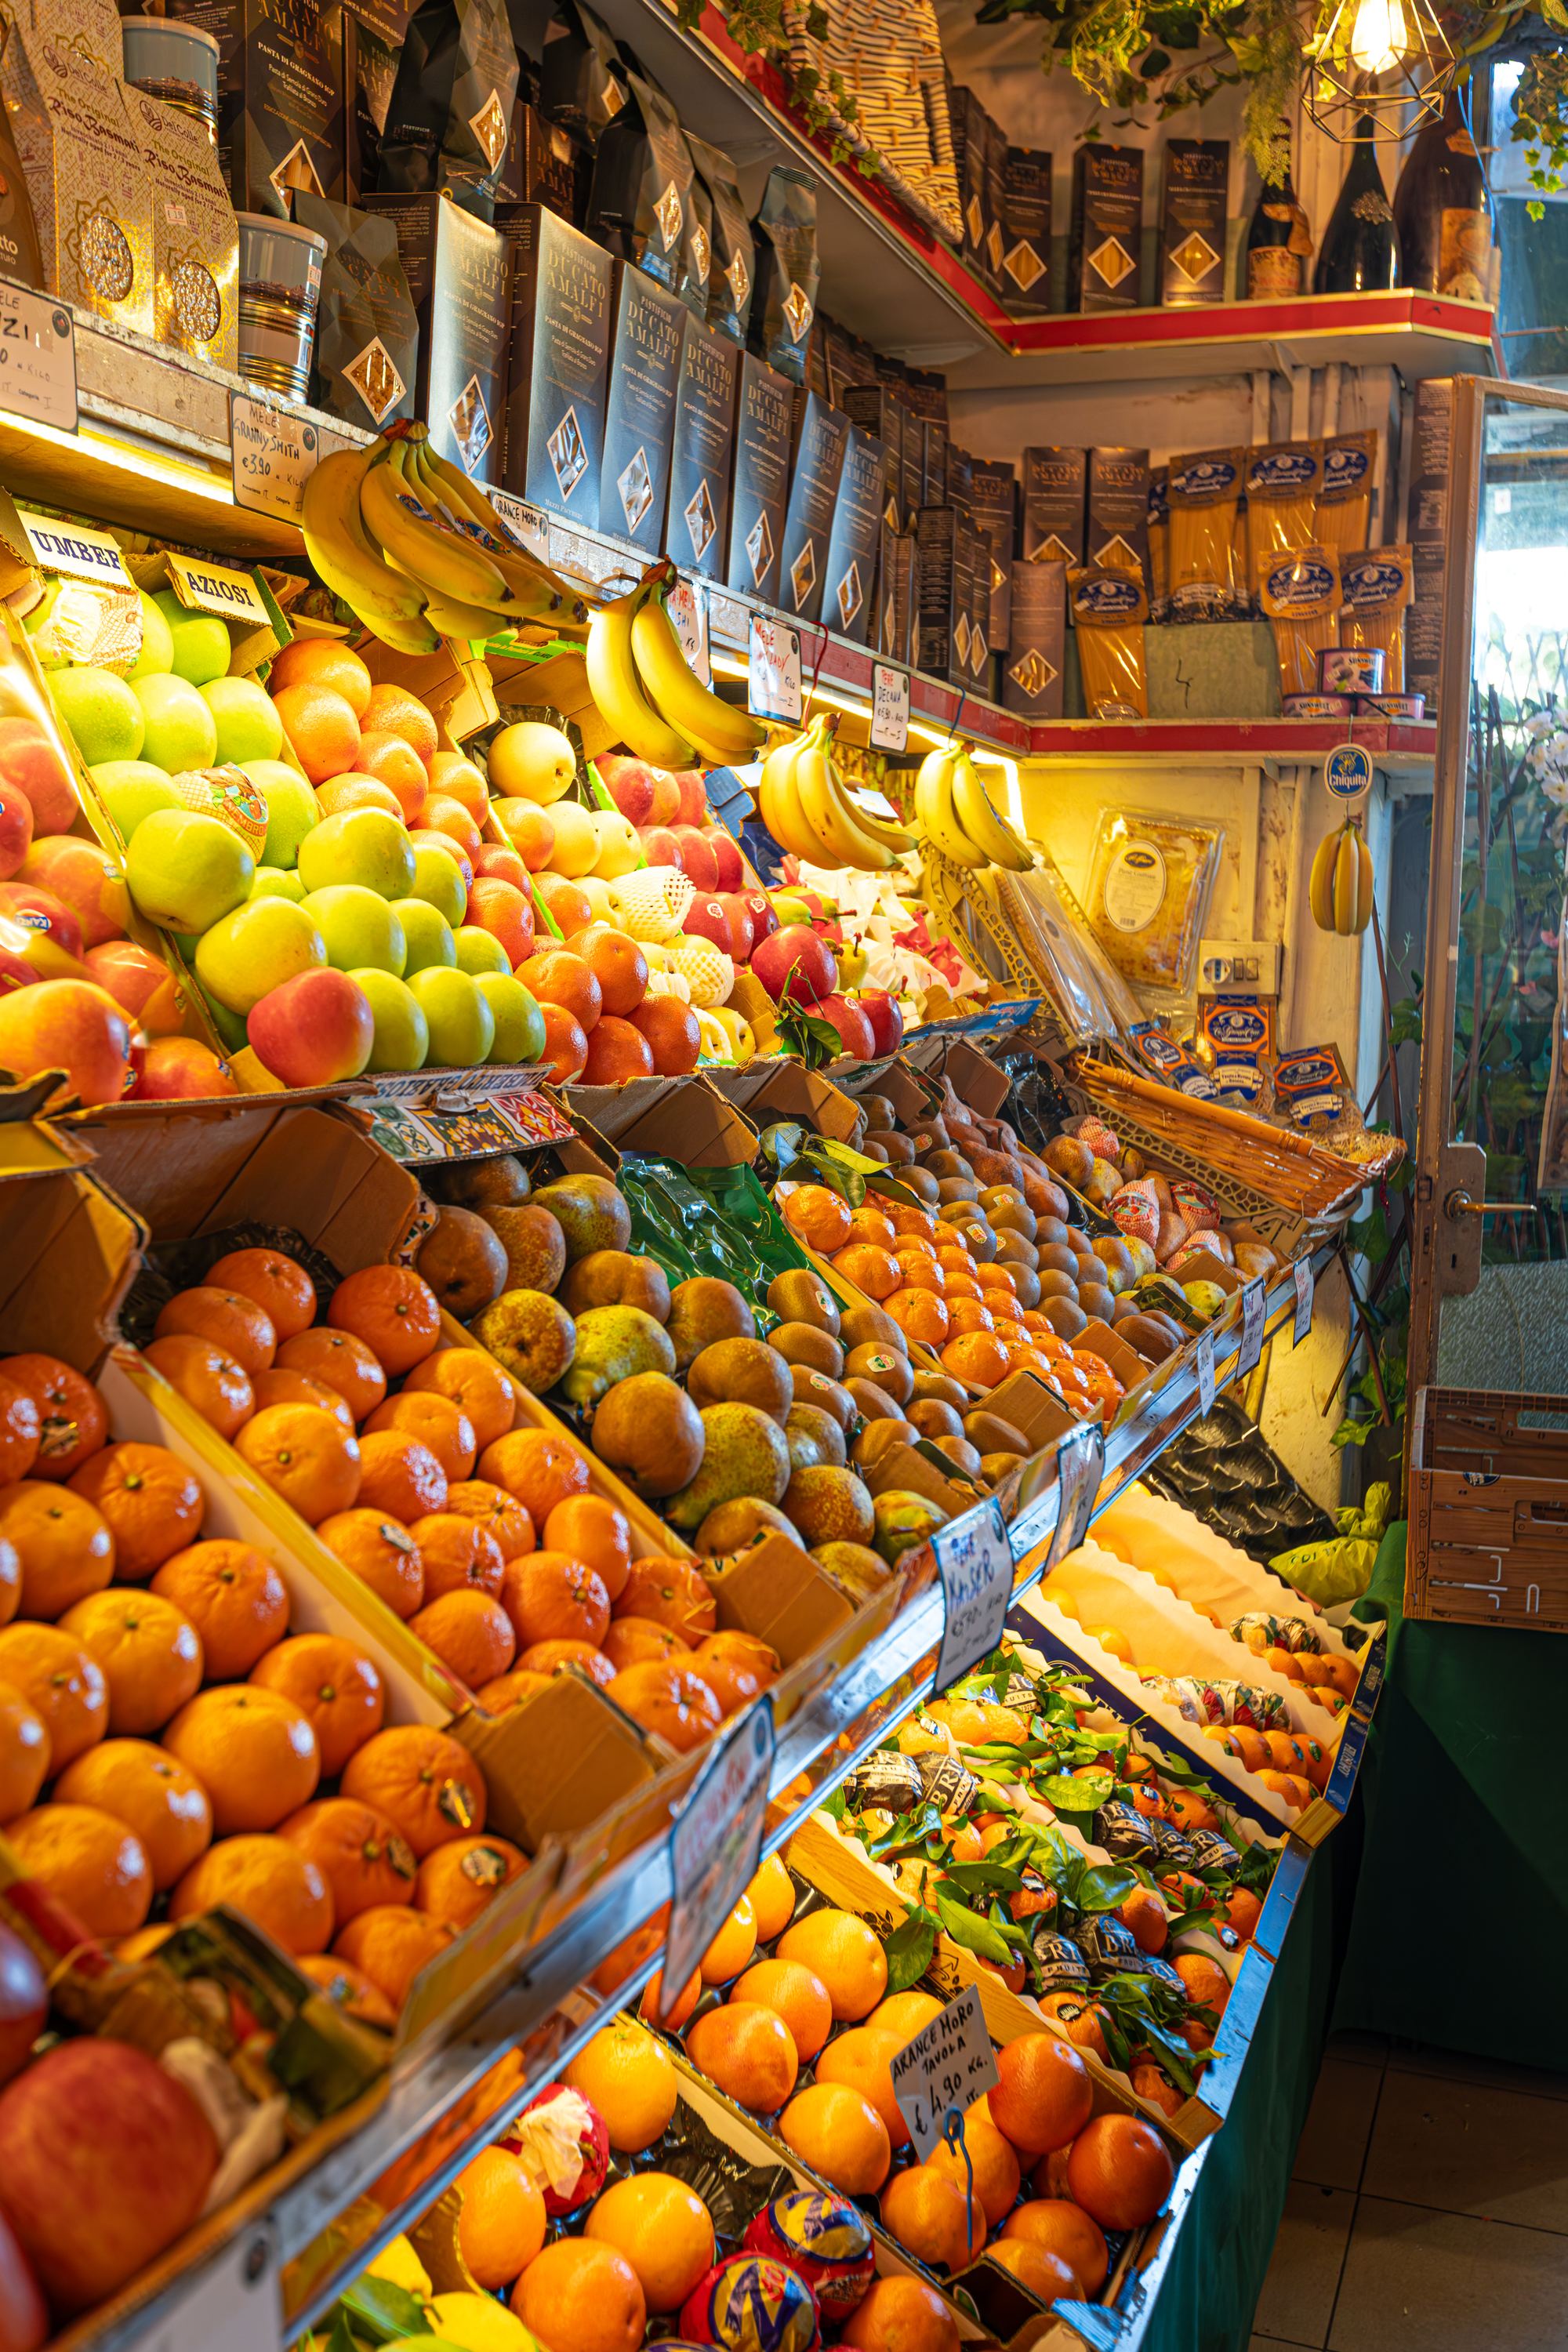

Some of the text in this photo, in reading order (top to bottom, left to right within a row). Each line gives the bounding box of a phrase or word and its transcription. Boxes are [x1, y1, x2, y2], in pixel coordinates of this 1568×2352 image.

[257, 42, 280, 60] PASTA
[281, 55, 289, 66] DI
[289, 61, 324, 88] GRAGNANO
[47, 96, 140, 154] Riso Basmati
[78, 98, 120, 127] Original
[143, 149, 229, 201] Riso Basmati
[151, 139, 209, 177] The Original
[547, 270, 603, 318] AMALFI
[548, 249, 606, 300] DUCATO
[627, 300, 679, 347] DUCATO
[641, 296, 672, 323] PASTIFICIO
[625, 318, 676, 364] AMALFI
[686, 361, 729, 401] AMALFI
[688, 343, 731, 385] DUCATO
[250, 404, 277, 428] MELE
[747, 401, 788, 436] AMALFI
[748, 384, 789, 420] DUCATO
[234, 417, 300, 460] GRANNY SMITH
[495, 499, 520, 521] ARANCE
[1328, 773, 1367, 790] Chiquita
[364, 1073, 463, 1099] GRAZIOS
[893, 2001, 975, 2082] ARANCE MORO
[921, 2035, 967, 2076] TAVOLA
